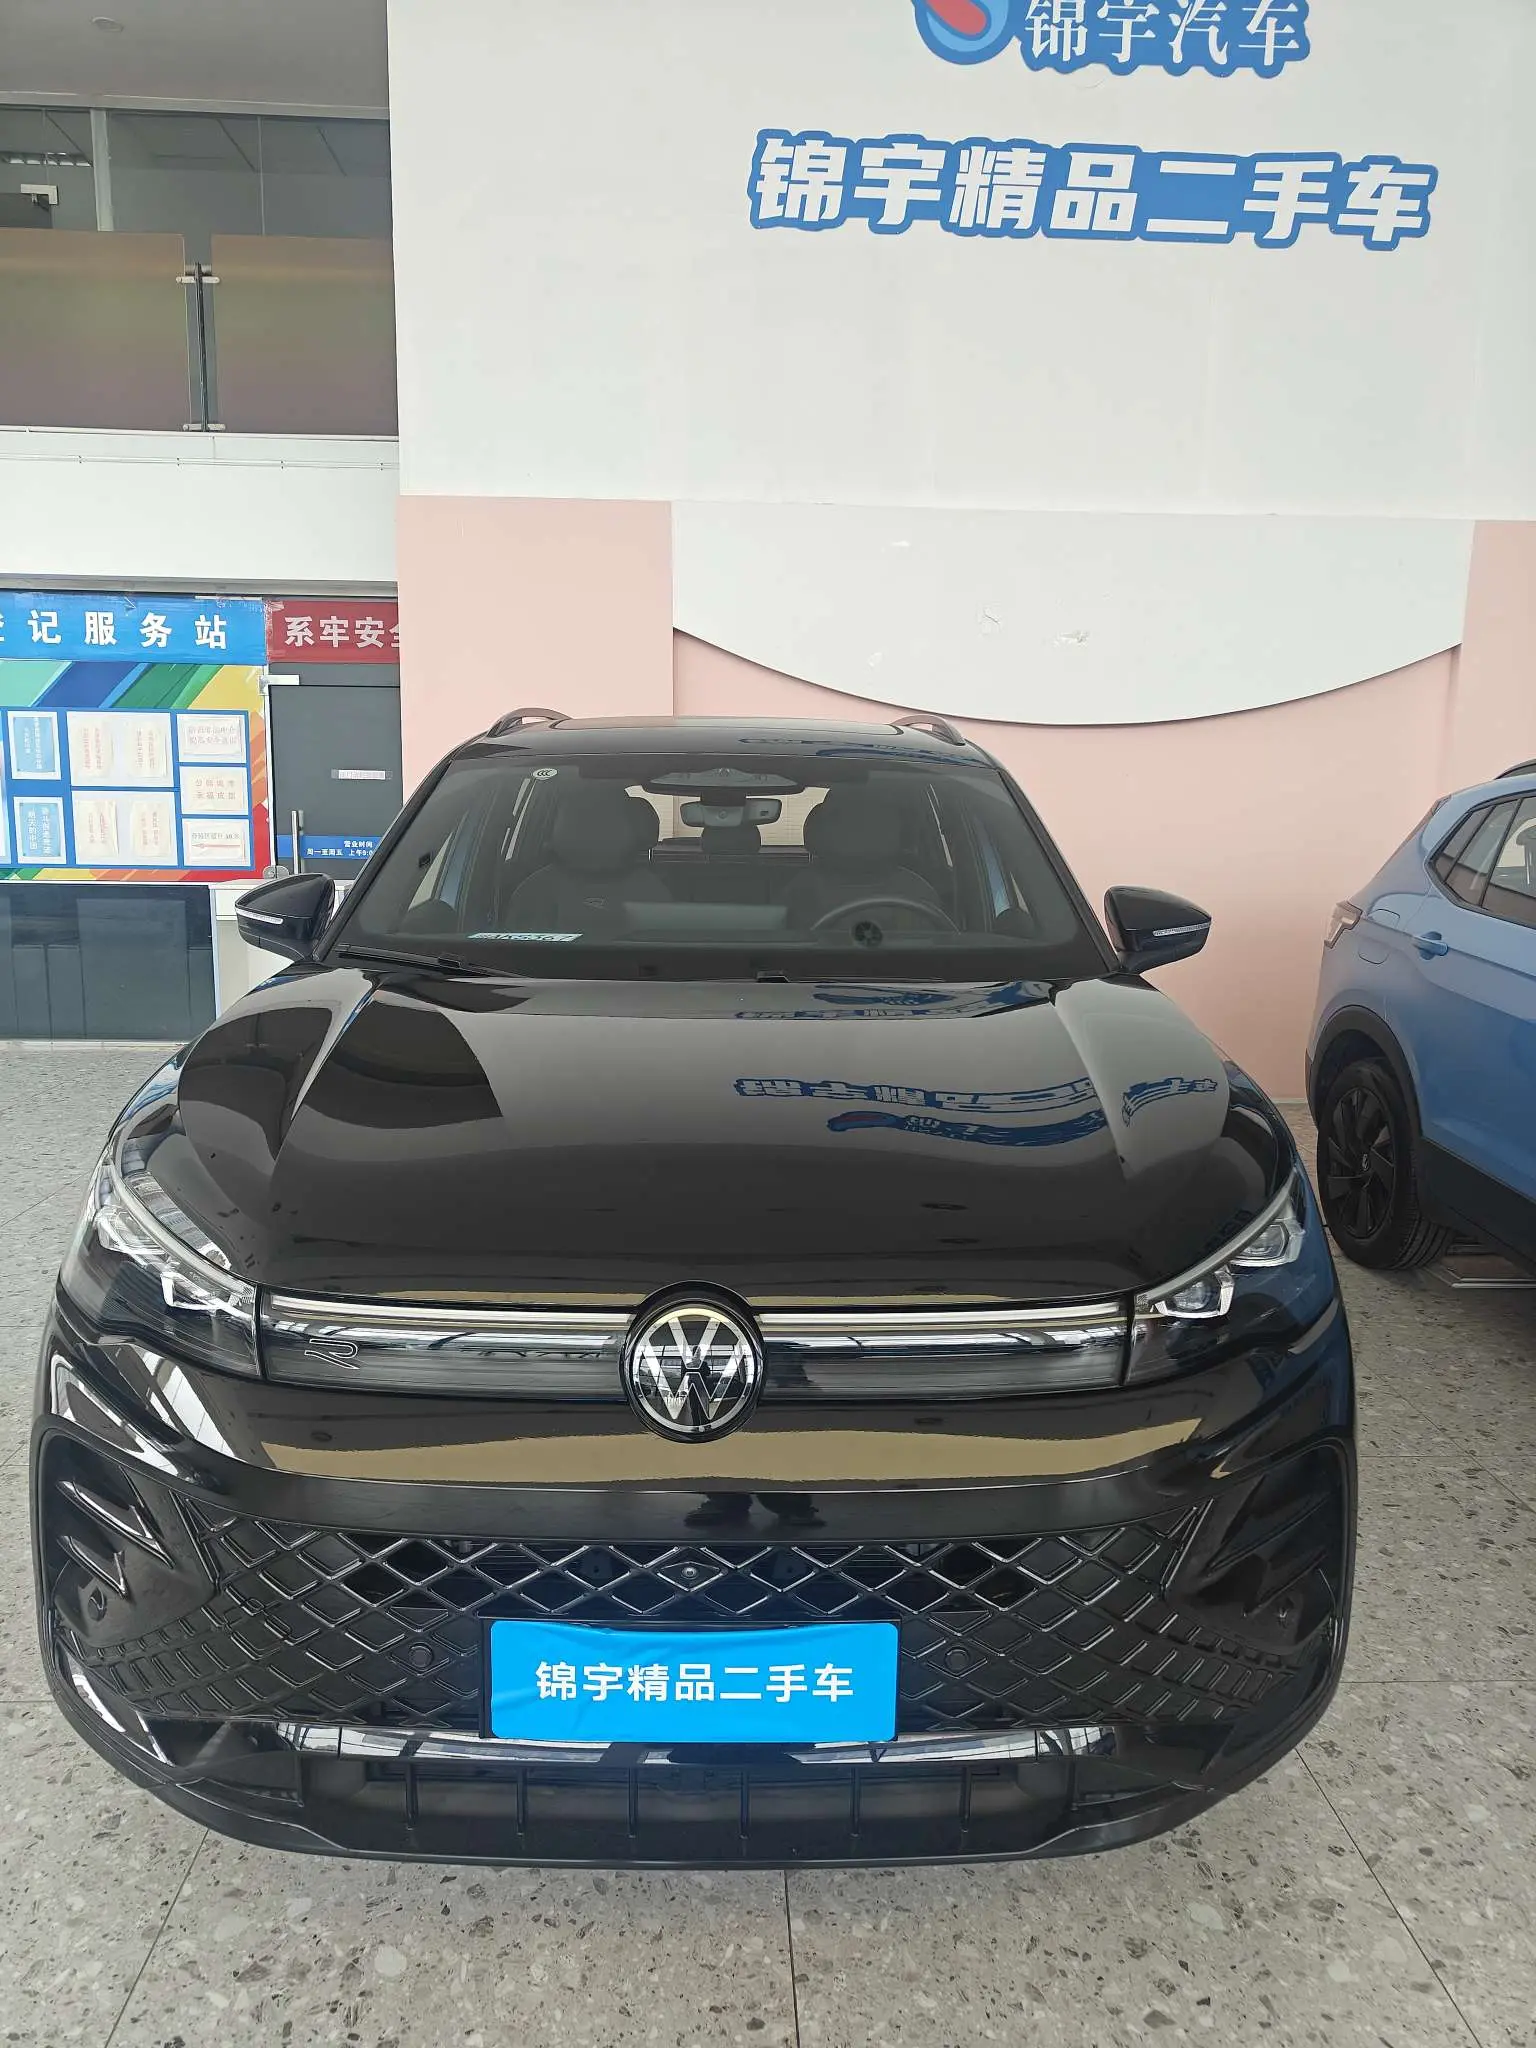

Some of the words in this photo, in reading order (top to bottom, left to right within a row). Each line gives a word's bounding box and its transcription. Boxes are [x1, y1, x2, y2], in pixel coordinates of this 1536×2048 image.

[1024, 0, 1301, 66] 锦宇汽车
[754, 137, 1431, 243] 锦宇精品二手车
[0, 609, 227, 650] 记服务站
[307, 848, 343, 856] 周一至周五
[535, 1660, 855, 1703] 锦宇精品二手车
